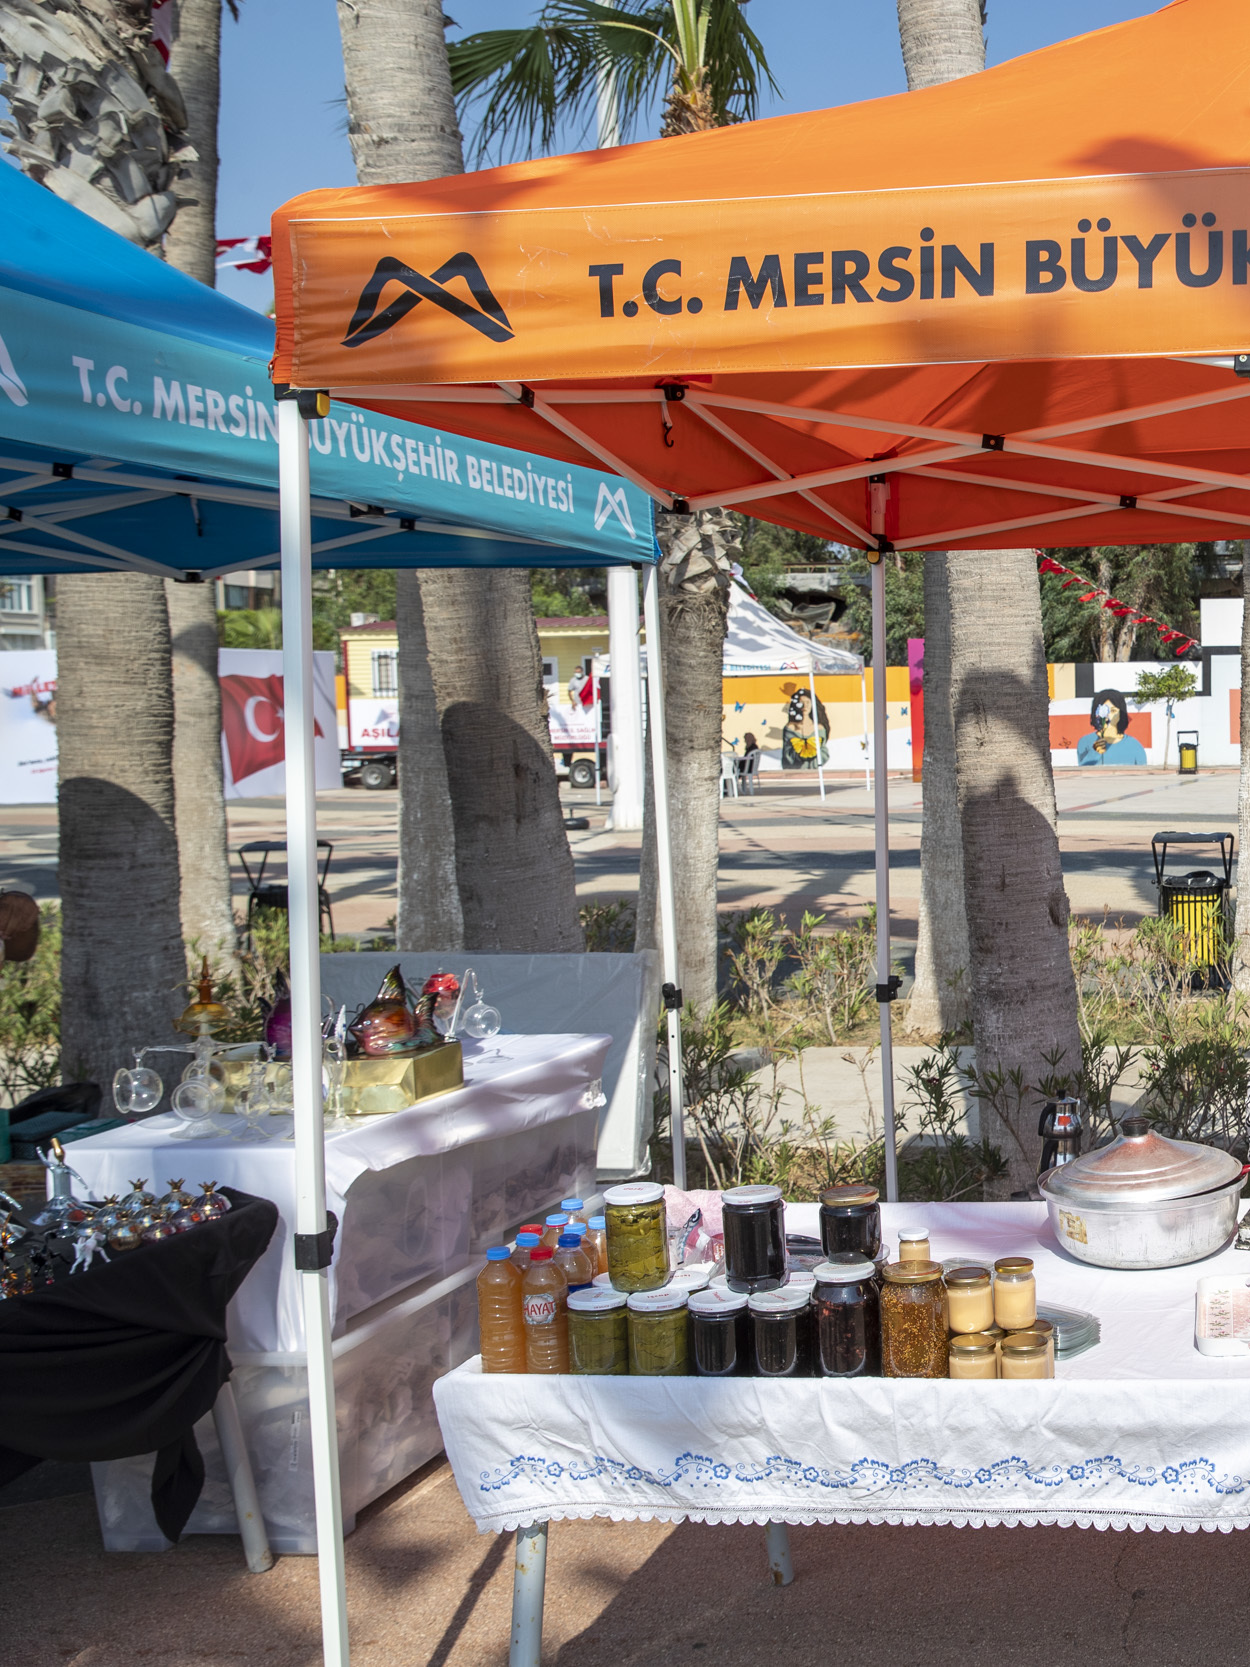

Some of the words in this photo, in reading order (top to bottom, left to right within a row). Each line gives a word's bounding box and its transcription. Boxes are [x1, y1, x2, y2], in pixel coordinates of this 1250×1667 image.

[588, 258, 703, 318] T.C.
[723, 226, 995, 312] MERSİN
[72, 355, 142, 416] T.C.
[152, 376, 279, 444] MERSİN
[308, 411, 462, 482] ÜYÜKŞEHİR
[466, 454, 575, 514] BELEDİYESİ
[523, 1301, 555, 1316] HAYAT
